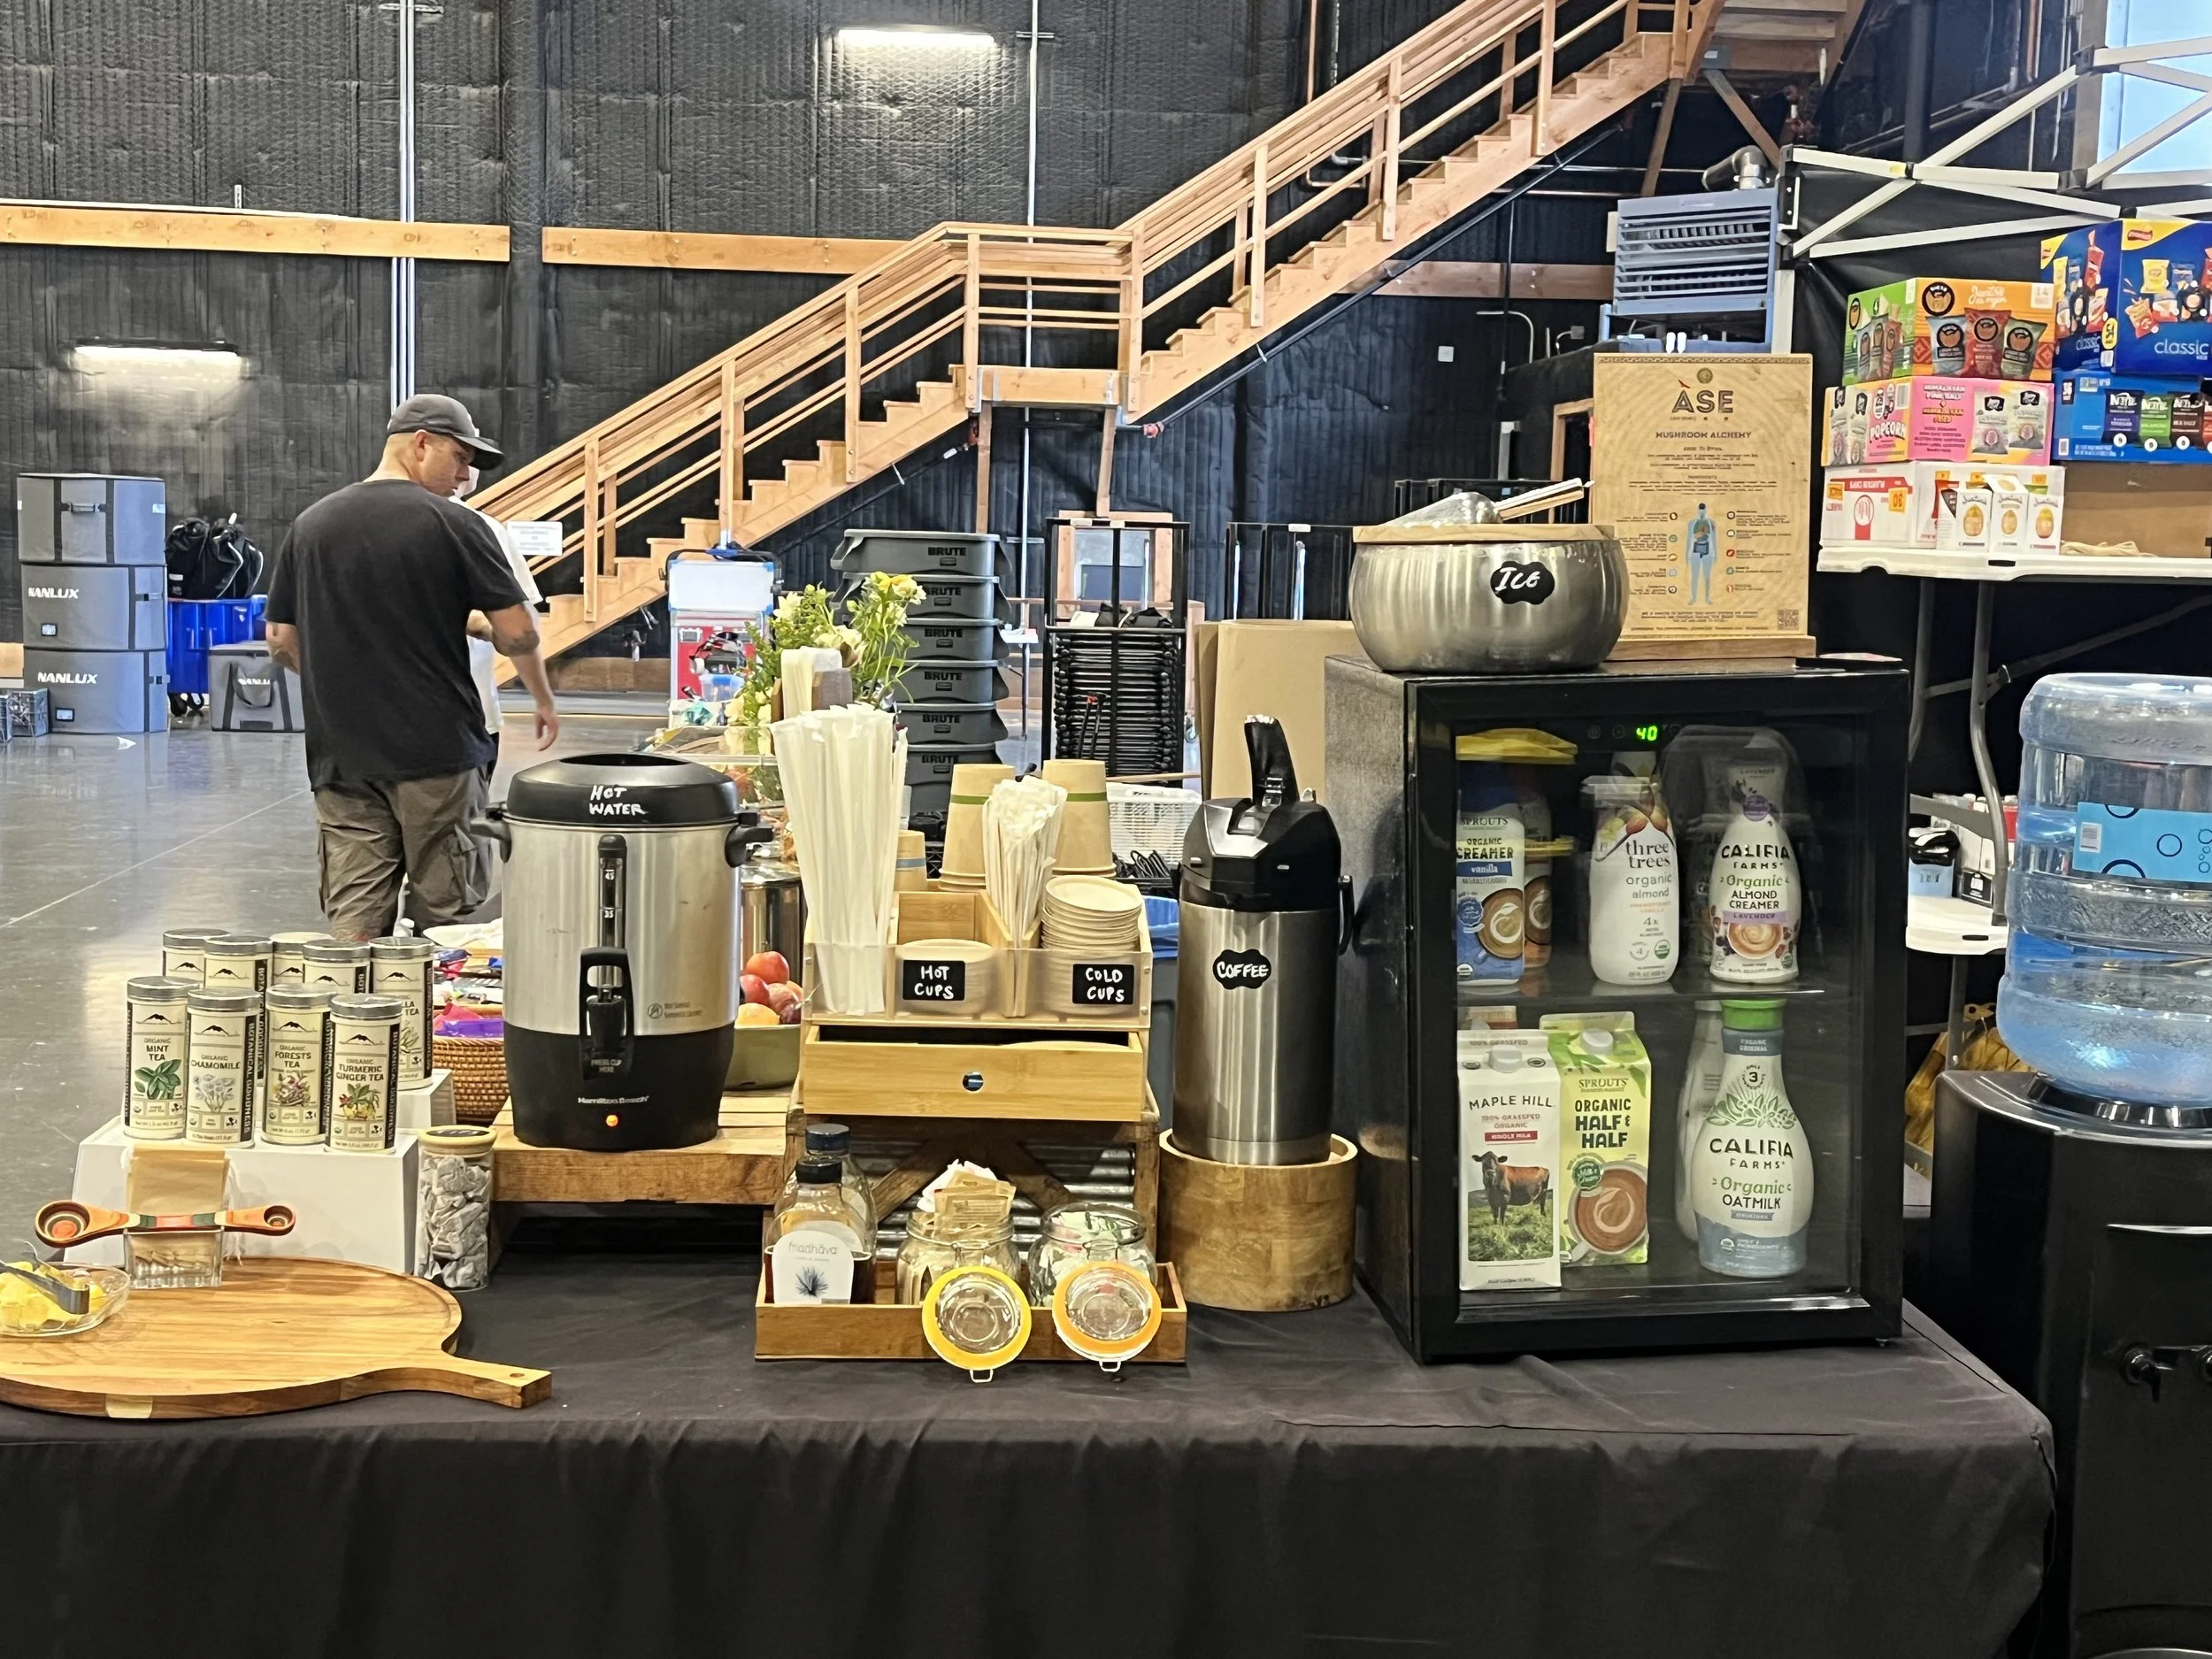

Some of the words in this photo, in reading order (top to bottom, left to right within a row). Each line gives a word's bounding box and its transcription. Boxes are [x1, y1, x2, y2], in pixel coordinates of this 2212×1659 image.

[2154, 339, 2209, 355] classic
[1869, 420, 1906, 442] POPCORN
[927, 546, 967, 557] BRUTE
[27, 587, 80, 600] NANLUX
[924, 587, 962, 596] BRUTE
[924, 628, 963, 638] BRUTE
[37, 672, 98, 685] NANLUX
[924, 671, 963, 681] BRUTE
[922, 714, 962, 724] BRUTE
[1635, 725, 1660, 742] 40
[921, 755, 960, 764] BRUTE
[590, 785, 628, 801] HOT
[588, 802, 648, 817] WATER
[1459, 816, 1509, 826] SPROUTS
[1466, 837, 1502, 846] ORGANIC
[1625, 840, 1670, 856] three
[1456, 847, 1514, 860] CREAMER
[1721, 844, 1790, 859] CALIFIA
[1471, 864, 1499, 874] vanilla
[1628, 856, 1671, 869] trees
[1625, 872, 1672, 887] organic
[1726, 873, 1783, 890] Organic
[1632, 887, 1670, 899] almond
[1731, 890, 1778, 900] ALMOND
[1729, 900, 1779, 910] CREAMER
[920, 964, 950, 981] HOT
[1085, 967, 1124, 984] COLD
[1216, 961, 1270, 979] COFFEE
[914, 982, 955, 1000] CUPS
[1087, 986, 1125, 1002] CUPS
[149, 1053, 166, 1062] TEA
[274, 1051, 311, 1060] FORESTS
[339, 1064, 383, 1073] TURMERIC
[336, 1072, 366, 1082] GINGER
[1578, 1078, 1629, 1088] SPROUTS
[1748, 1071, 1759, 1083] 3
[1469, 1095, 1517, 1111] MAPLE
[1522, 1095, 1554, 1108] HILL
[1574, 1098, 1632, 1112] ORGANIC
[1575, 1115, 1621, 1132] HALF
[1581, 1133, 1628, 1148] HALF
[1709, 1138, 1794, 1160] CALIFIA
[1720, 1176, 1786, 1196] Organic
[1722, 1194, 1782, 1210] OATMILK
